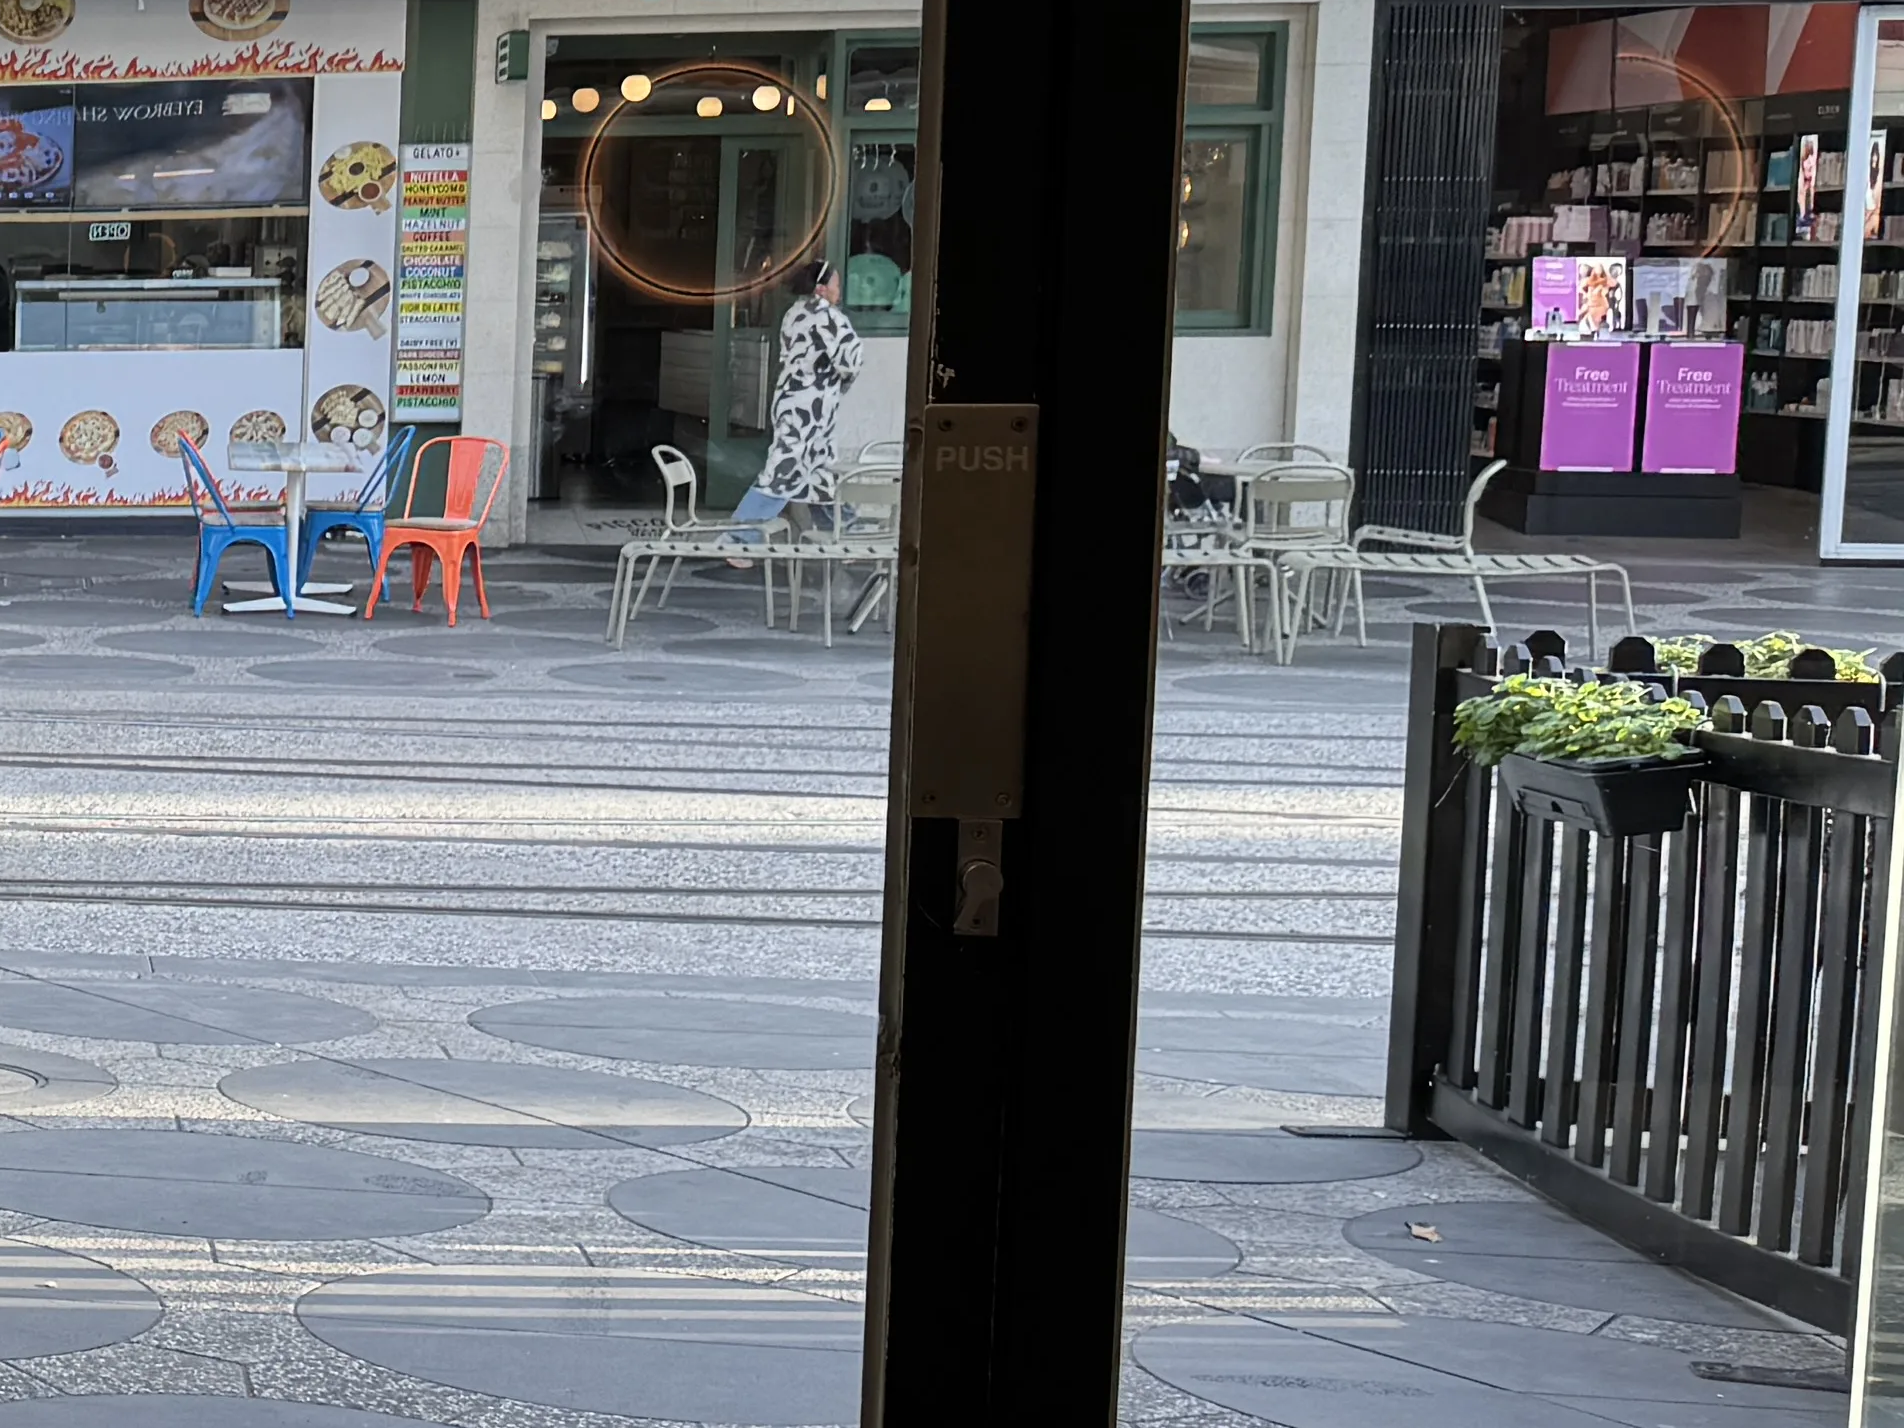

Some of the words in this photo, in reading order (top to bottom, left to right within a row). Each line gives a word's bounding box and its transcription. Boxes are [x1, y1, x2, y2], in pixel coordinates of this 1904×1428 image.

[413, 147, 453, 160] GELATO
[410, 171, 459, 183] NUTELLA
[405, 184, 465, 195] HONEYCOMB
[404, 197, 434, 207] PEANUT
[419, 208, 448, 218] MINT
[404, 218, 461, 230] HAZELNUT
[412, 231, 451, 242] COFFEE
[403, 254, 461, 267] CHOCOLATE
[405, 266, 456, 278] COCONUT
[400, 278, 461, 290] PISTACCHIO
[400, 315, 461, 324] STRACCIATELLA
[397, 362, 459, 372] PASSIONFRUIT
[410, 373, 446, 384] LEMON
[1575, 367, 1610, 382] Free
[1677, 368, 1713, 382] Free
[1554, 378, 1628, 394] Treatment
[1656, 379, 1731, 395] Treatment
[396, 396, 457, 408] PISTACCHIO
[936, 446, 1029, 472] PUSH
